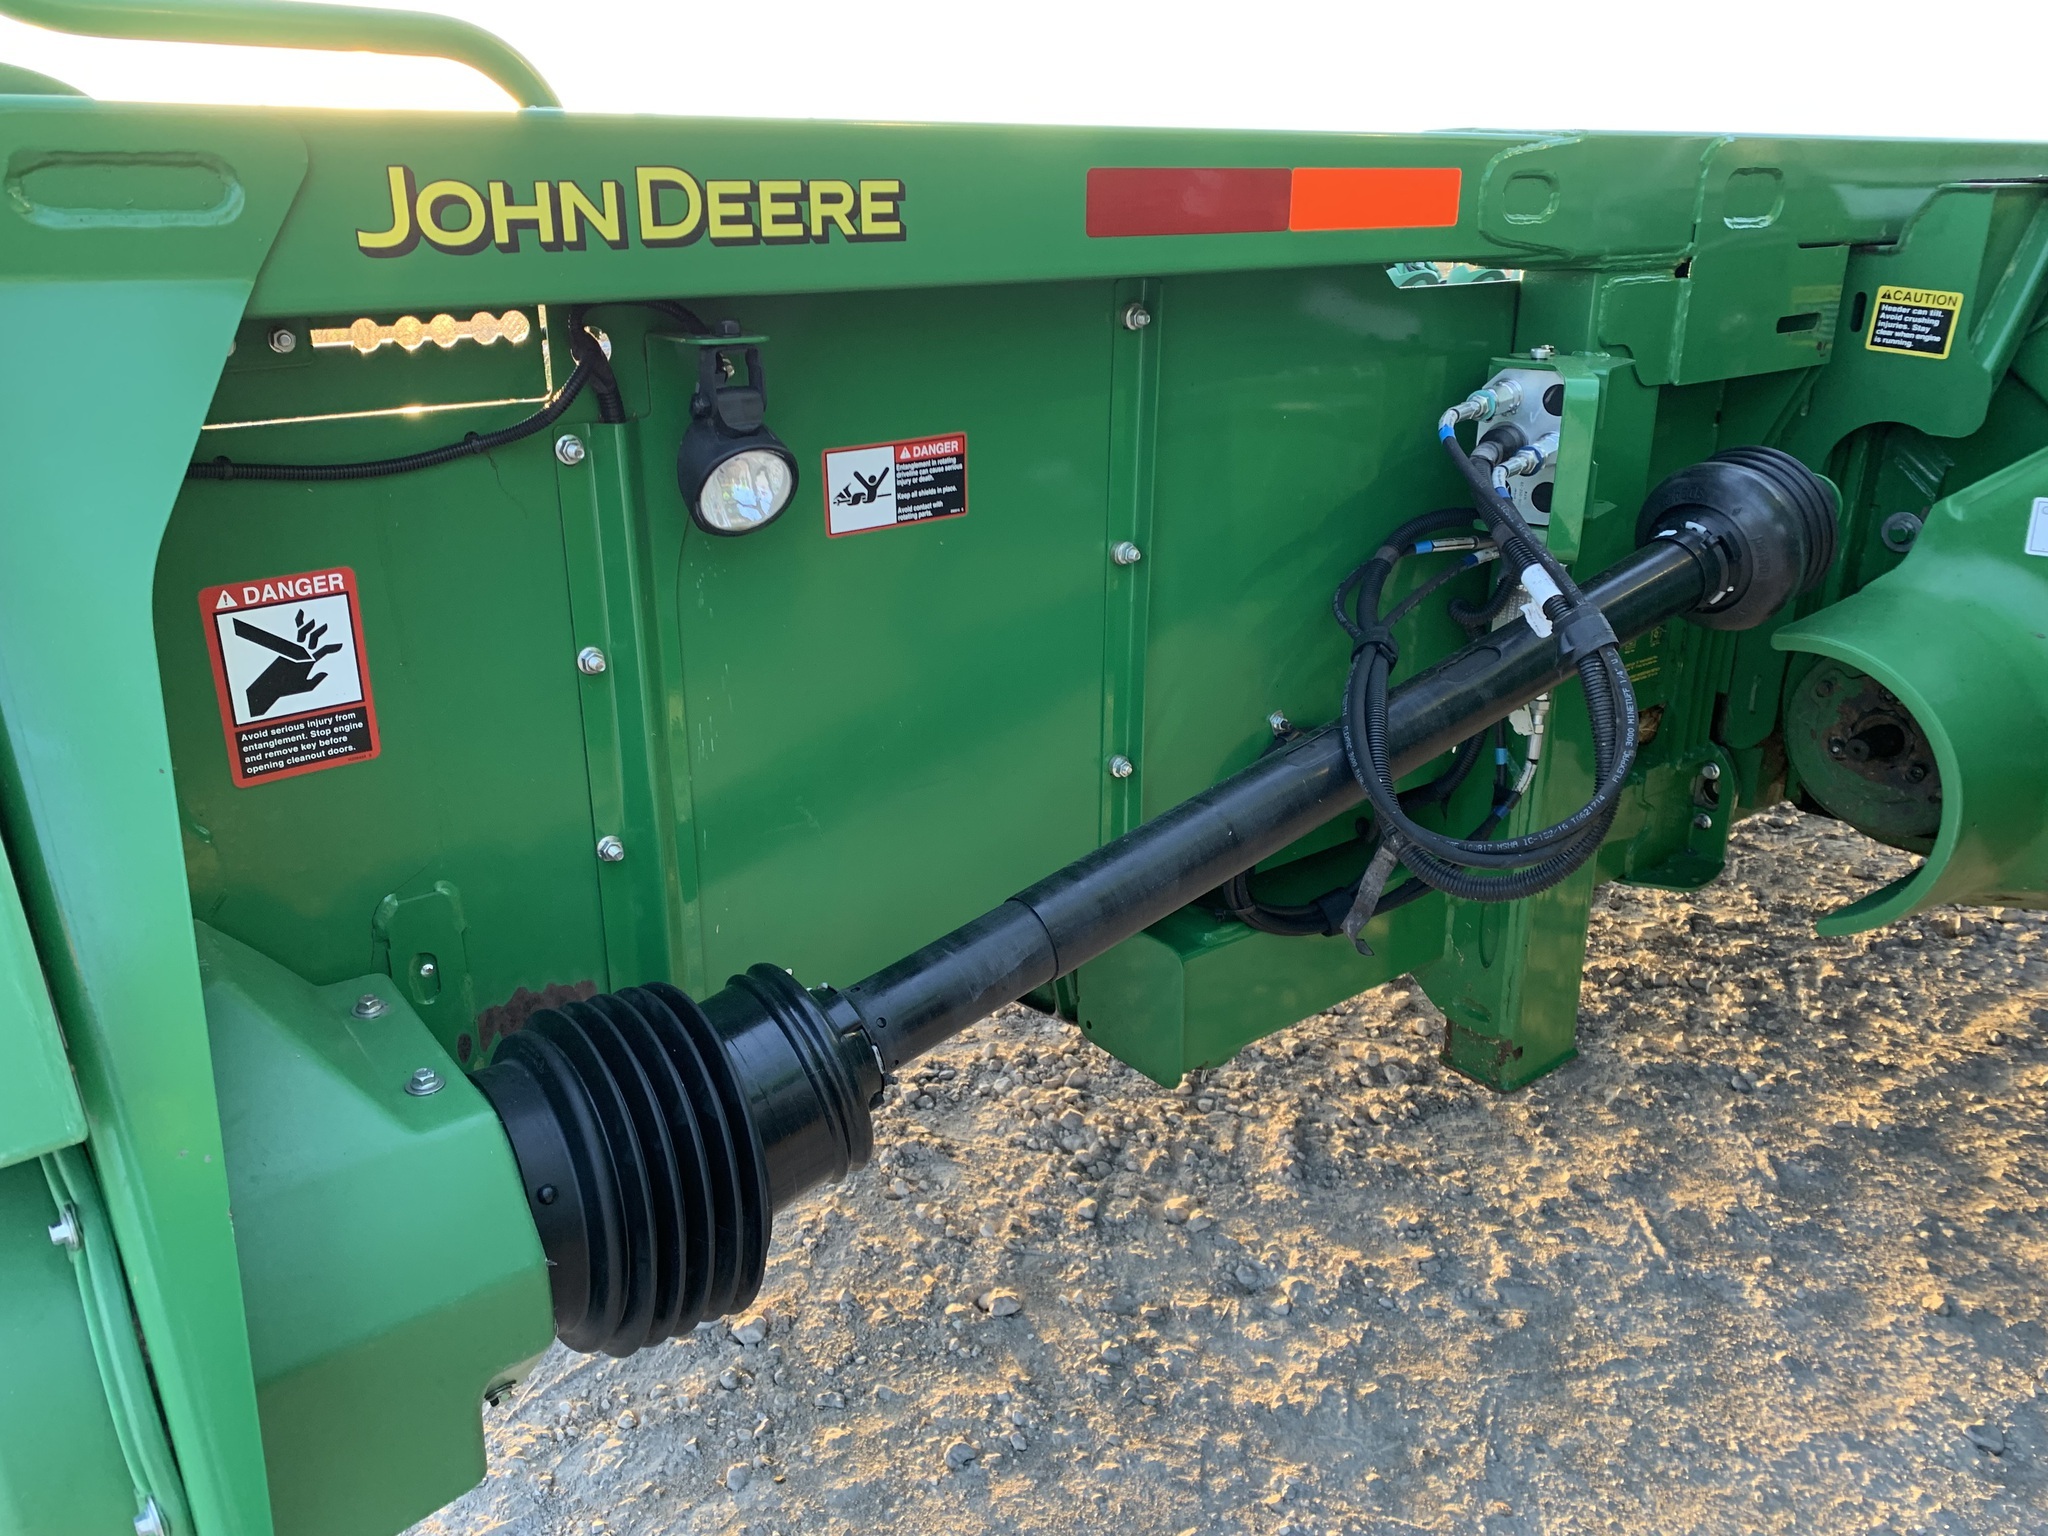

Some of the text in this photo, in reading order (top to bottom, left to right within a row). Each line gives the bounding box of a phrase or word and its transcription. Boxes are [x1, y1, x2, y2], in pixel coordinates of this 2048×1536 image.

[356, 165, 907, 258] JOHN DEERE
[1893, 290, 1959, 307] CAUTION
[1881, 304, 1911, 314] Header
[1911, 308, 1928, 316] can
[1877, 320, 1931, 334] injuries. Stay
[1879, 312, 1940, 327] Avoid crushing
[1873, 335, 1914, 348] is running.
[1875, 328, 1941, 343] clear when engine
[913, 441, 959, 457] DANGER
[897, 505, 913, 515] Avoid
[913, 502, 933, 512] contact
[243, 573, 345, 605] DANGER
[241, 712, 356, 742] Avoid serious injury from
[242, 721, 364, 753] entanglement. Stop engine
[1625, 727, 1635, 747] 3000
[244, 735, 348, 764] and remove key before
[246, 744, 356, 775] opening cleanout doors.
